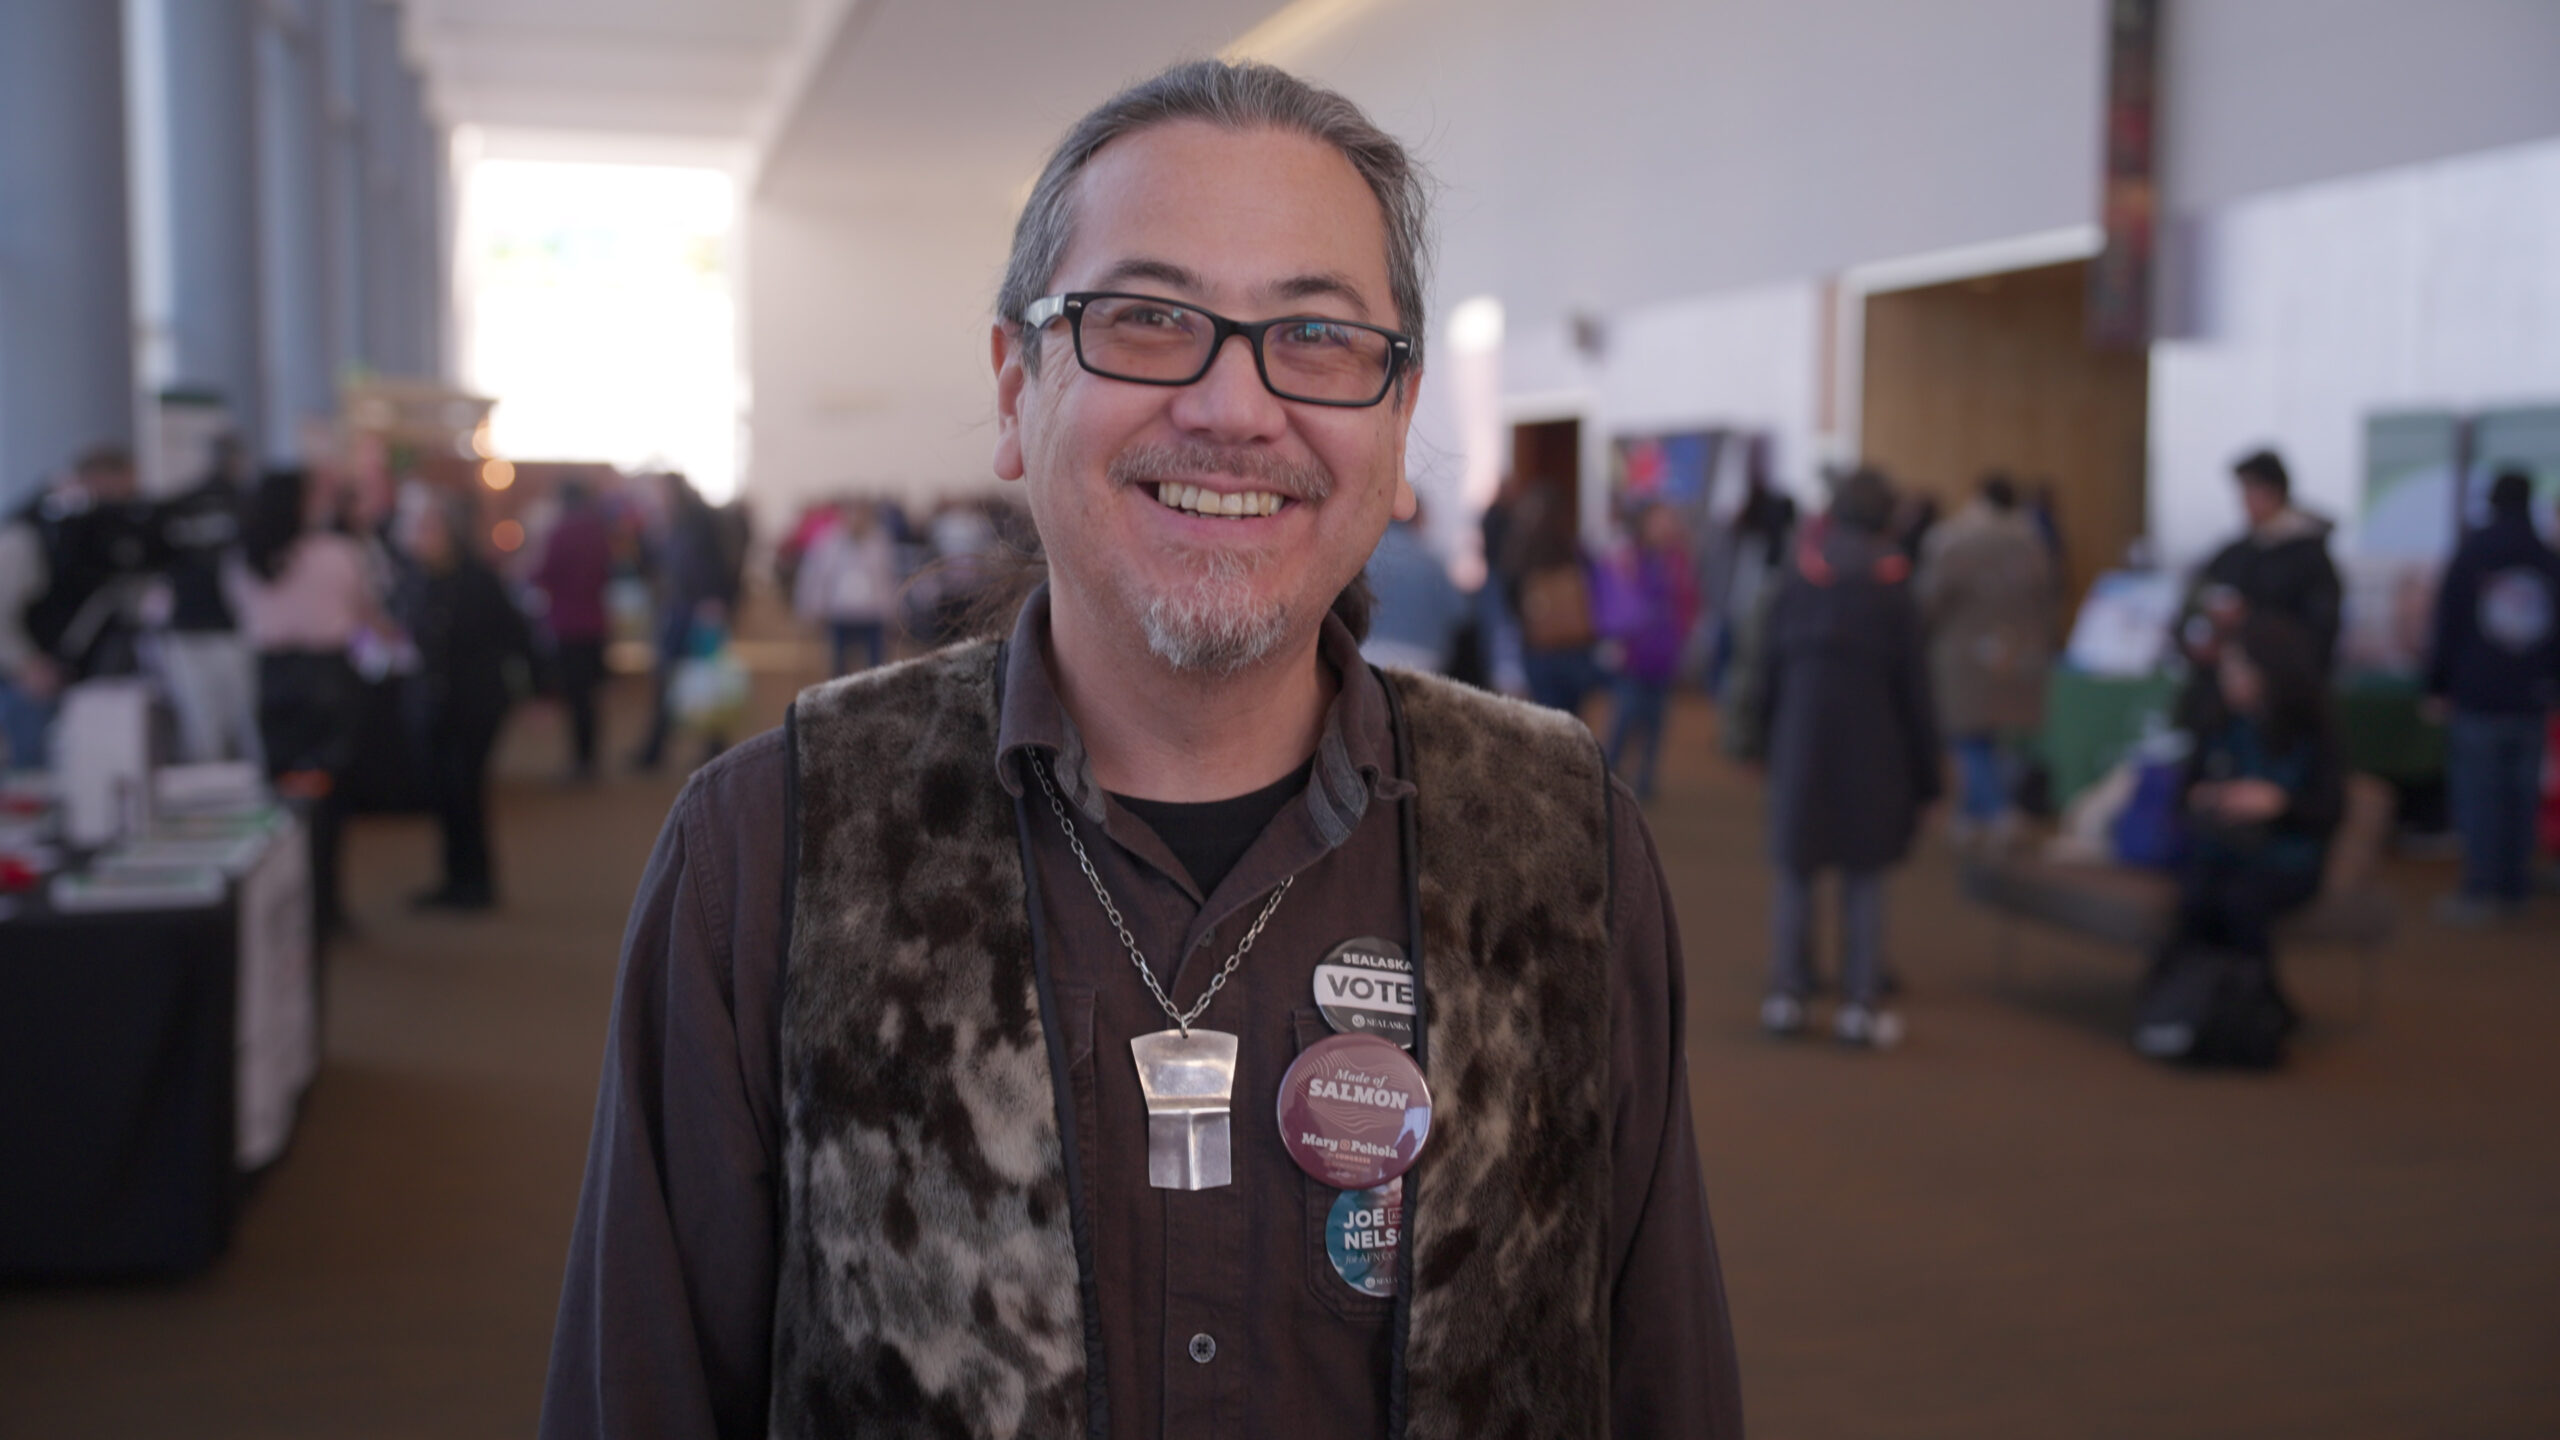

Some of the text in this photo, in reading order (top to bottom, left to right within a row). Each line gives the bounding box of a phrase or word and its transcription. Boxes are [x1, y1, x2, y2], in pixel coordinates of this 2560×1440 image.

[1342, 952, 1413, 971] SEALASKA
[1326, 973, 1413, 1005] VOTE
[1335, 1068, 1388, 1088] Made of
[1309, 1078, 1409, 1110] SALMON
[1302, 1132, 1399, 1159] Mary Peltola
[1343, 1208, 1385, 1229] JOE
[1344, 1228, 1401, 1250] NELS
